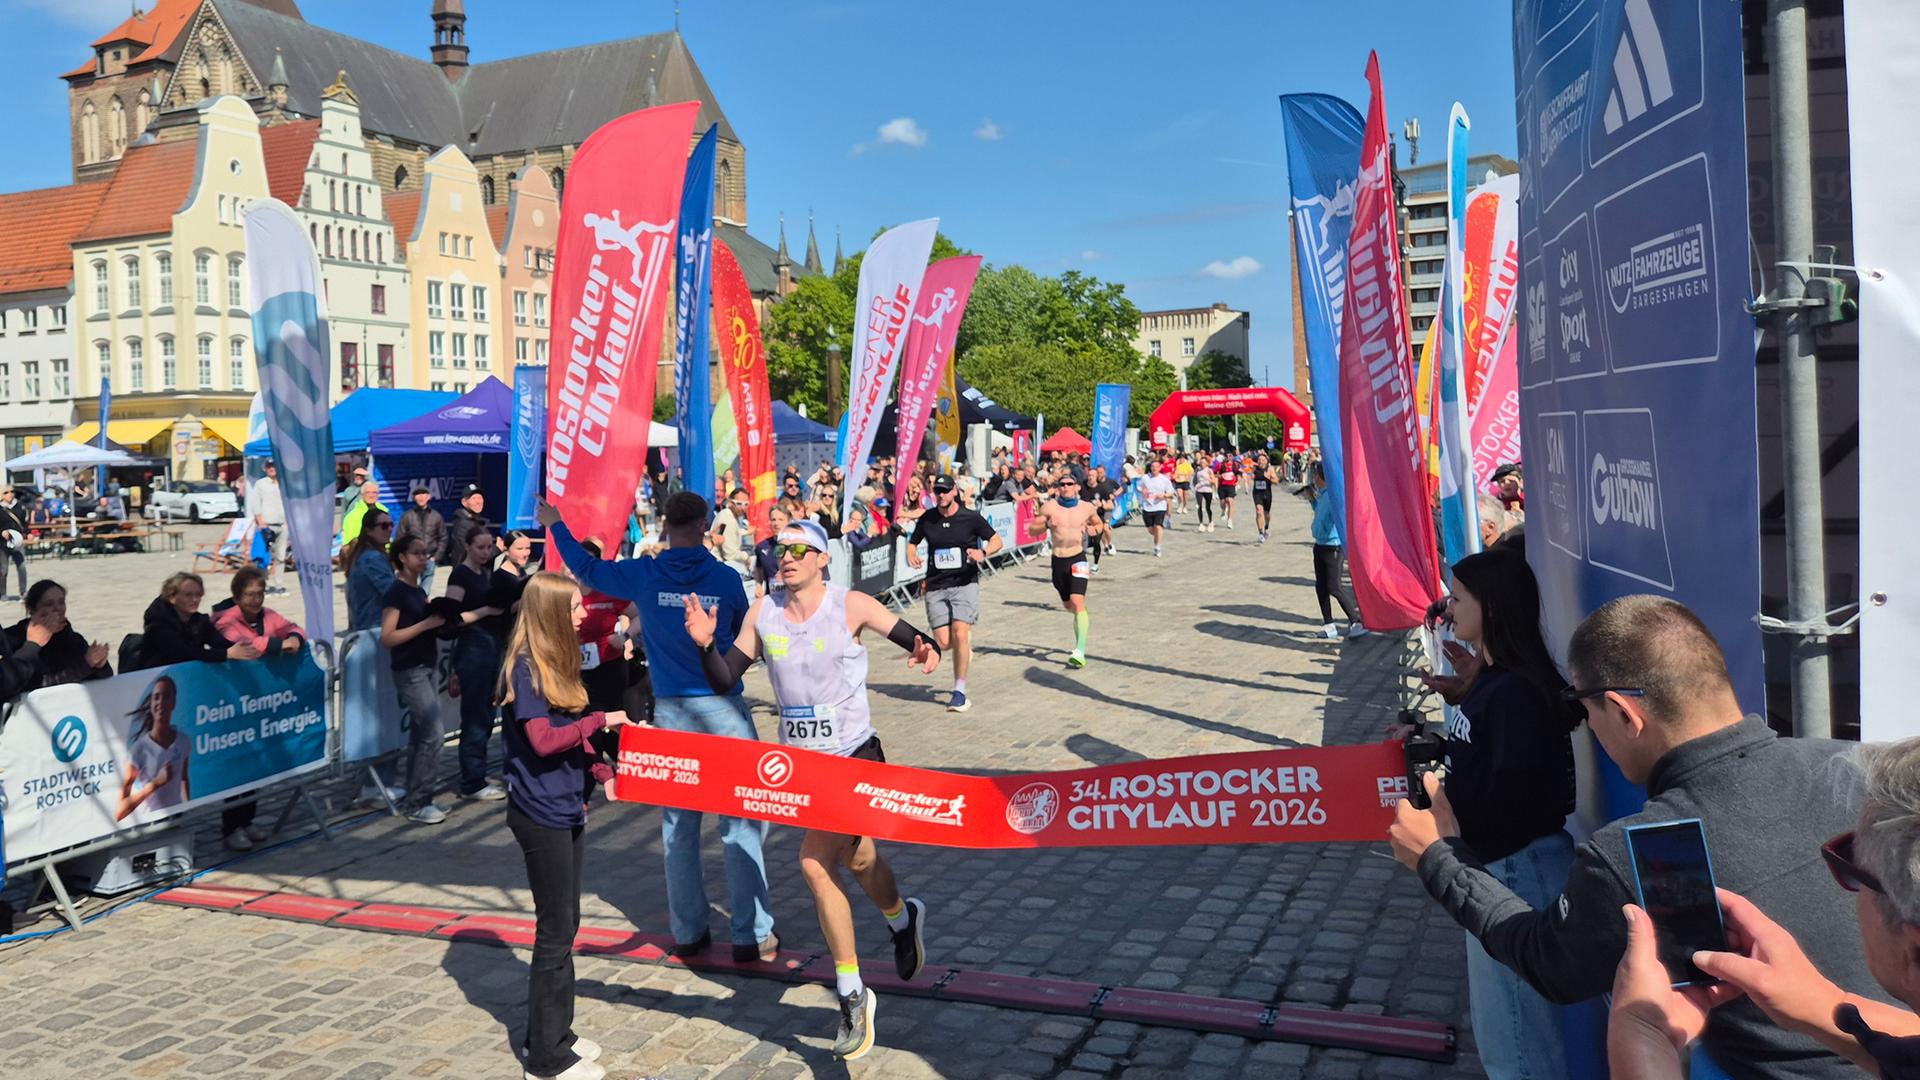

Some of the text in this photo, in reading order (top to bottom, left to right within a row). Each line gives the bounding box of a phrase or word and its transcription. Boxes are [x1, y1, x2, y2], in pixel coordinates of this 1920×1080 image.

[1610, 238, 1701, 288] NUTZ FAHRZEUGE
[1632, 278, 1709, 310] BARGESHAGEN
[547, 253, 611, 498] Rostocker
[578, 278, 638, 458] Citylauf
[195, 688, 298, 726] Dein Tempo.
[195, 706, 322, 756] Unsere Energie.
[786, 720, 833, 739] 2675
[23, 759, 115, 796] STADTWERKE
[673, 769, 700, 786] 2026
[36, 780, 101, 810] ROSTOCK
[733, 784, 810, 807] STADTWERKE
[743, 799, 798, 818] ROSTOCK
[853, 782, 951, 807] Rostocker
[869, 795, 939, 818] Citylauf
[1067, 796, 1328, 831] CITYLAUF 2026
